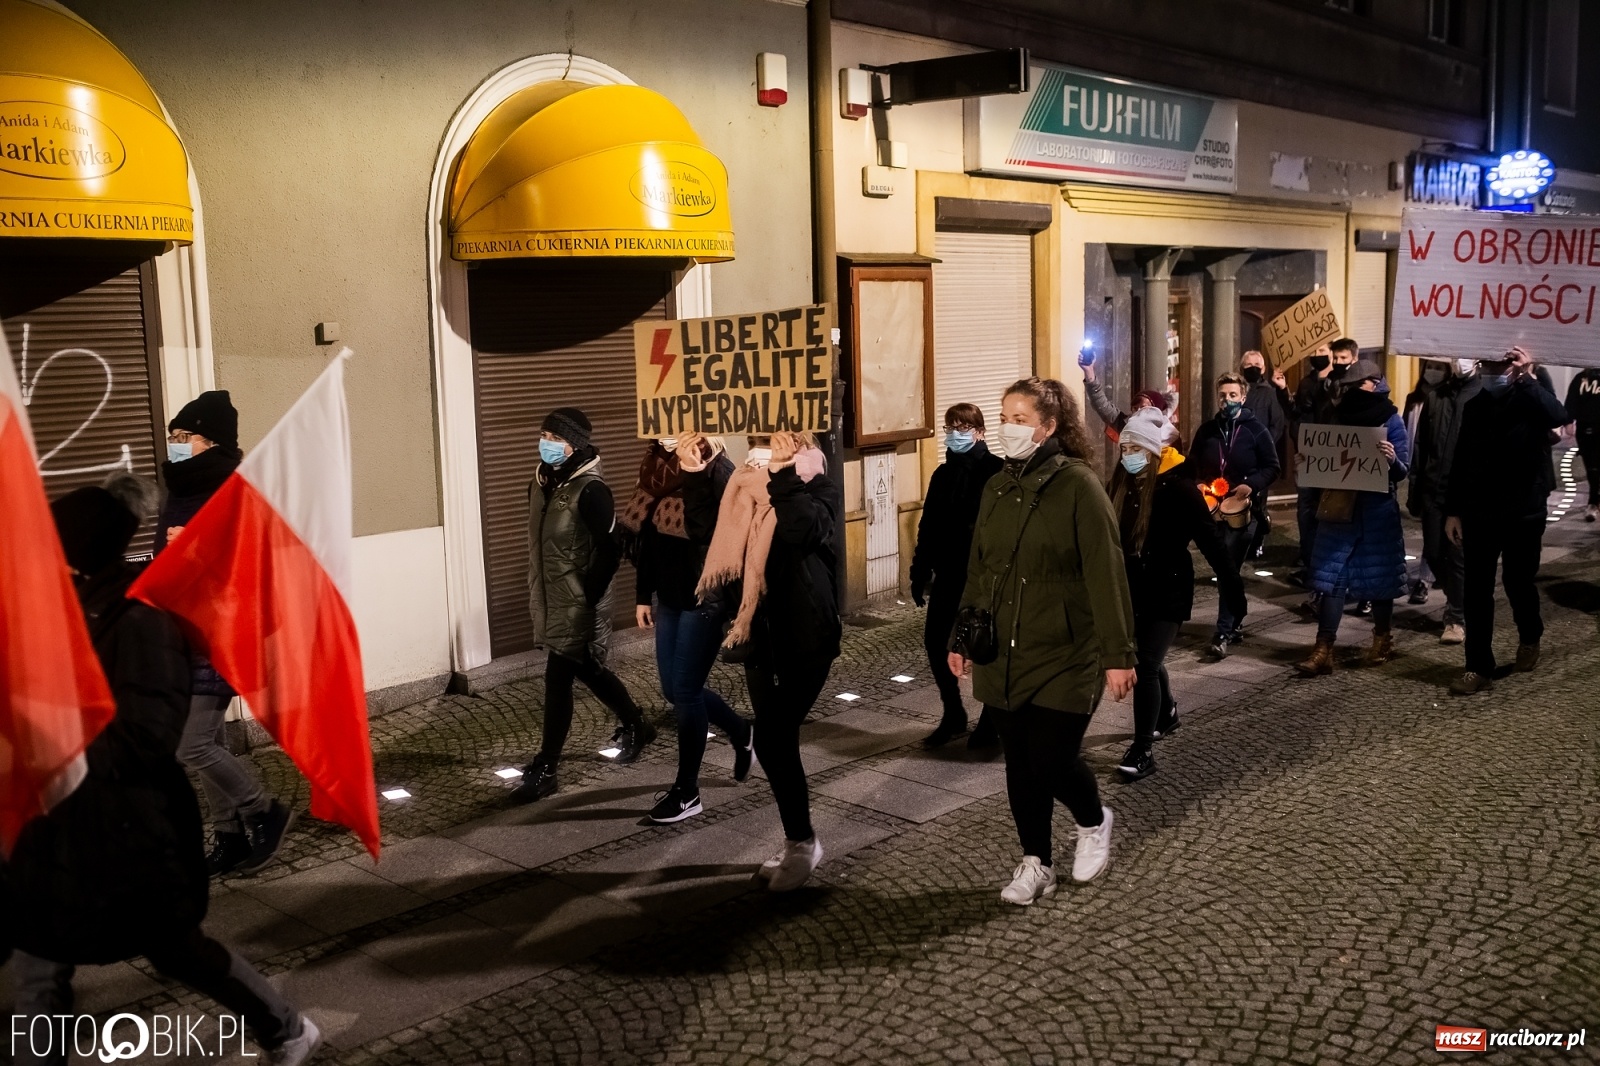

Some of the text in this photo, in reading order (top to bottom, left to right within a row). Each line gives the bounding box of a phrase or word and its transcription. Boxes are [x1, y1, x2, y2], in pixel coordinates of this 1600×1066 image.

[0, 113, 89, 136] Anida i Adam
[1062, 84, 1182, 142] FUJIFILM
[1036, 141, 1188, 172] LABORATORIUM FOTOGRAFICZNE
[1202, 138, 1230, 154] STUDIO
[682, 172, 700, 185] Adam
[1413, 158, 1481, 207] KANTOR
[1499, 166, 1540, 179] KANTOR
[643, 185, 712, 206] Markiewka
[53, 212, 149, 231] CUKIERNIA
[457, 239, 523, 254] PIEKARNIA
[526, 237, 610, 251] CUKIERNIA
[614, 237, 684, 250] PIEKARNIA
[686, 238, 729, 250] CUKIERNIA
[1408, 228, 1600, 267] W OBRONIE
[1410, 273, 1597, 325] WOLNOŚCI
[1267, 294, 1327, 346] JEJ CIAŁO
[1274, 312, 1338, 368] JEJ WYBÓR
[640, 390, 830, 436] WYPIERDALAJTE
[1303, 429, 1362, 448] WOLNA
